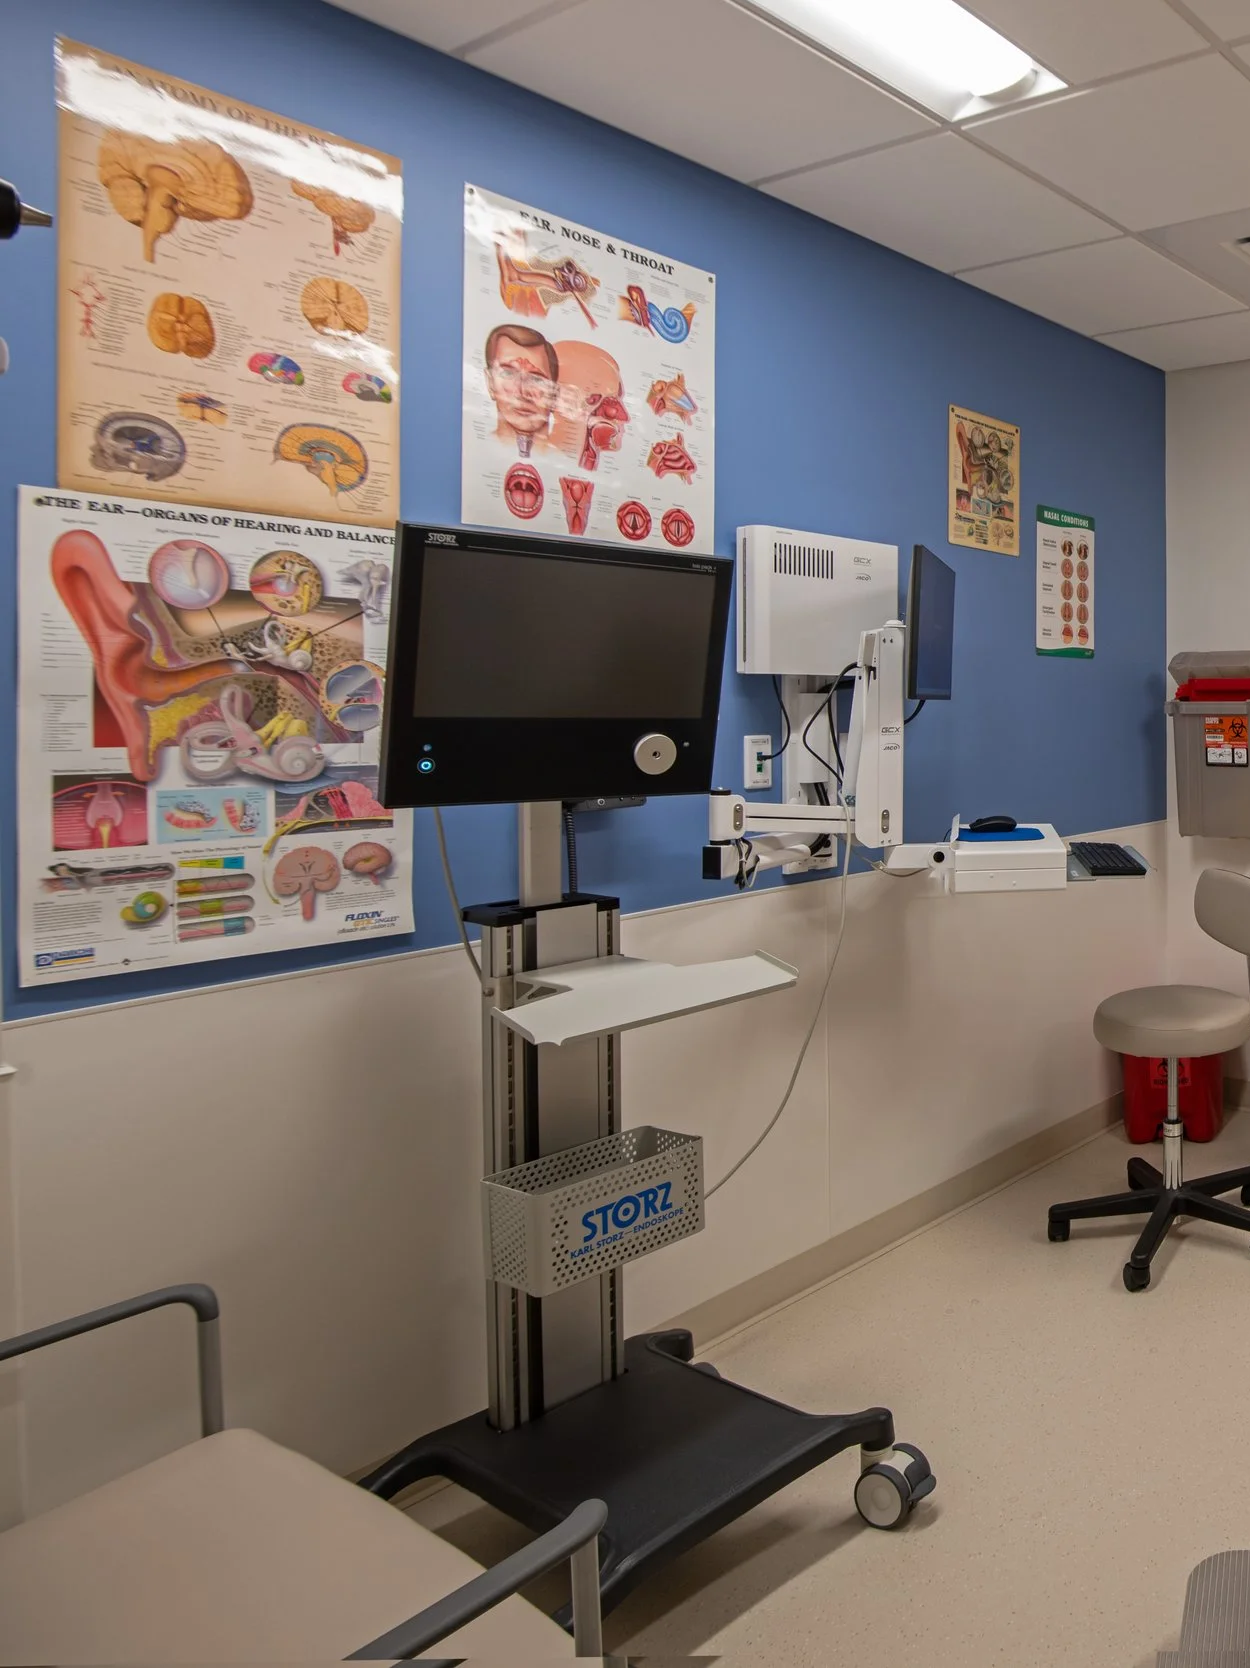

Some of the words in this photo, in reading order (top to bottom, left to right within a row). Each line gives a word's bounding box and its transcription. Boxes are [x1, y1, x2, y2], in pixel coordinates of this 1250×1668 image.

[227, 105, 258, 125] OF
[561, 225, 601, 250] NOSE
[606, 242, 617, 256] &
[620, 247, 675, 276] THROAT
[43, 495, 81, 510] THE
[211, 514, 232, 527] OF
[233, 517, 301, 535] HEARING
[304, 527, 333, 539] AND
[336, 530, 395, 545] BALANCE
[1043, 510, 1060, 521] NASAL
[1060, 514, 1089, 528] CONDITIONS
[428, 532, 457, 544] STORZ
[881, 726, 901, 734] GCX
[582, 1181, 673, 1243] STORZ
[570, 1244, 594, 1259] KARL
